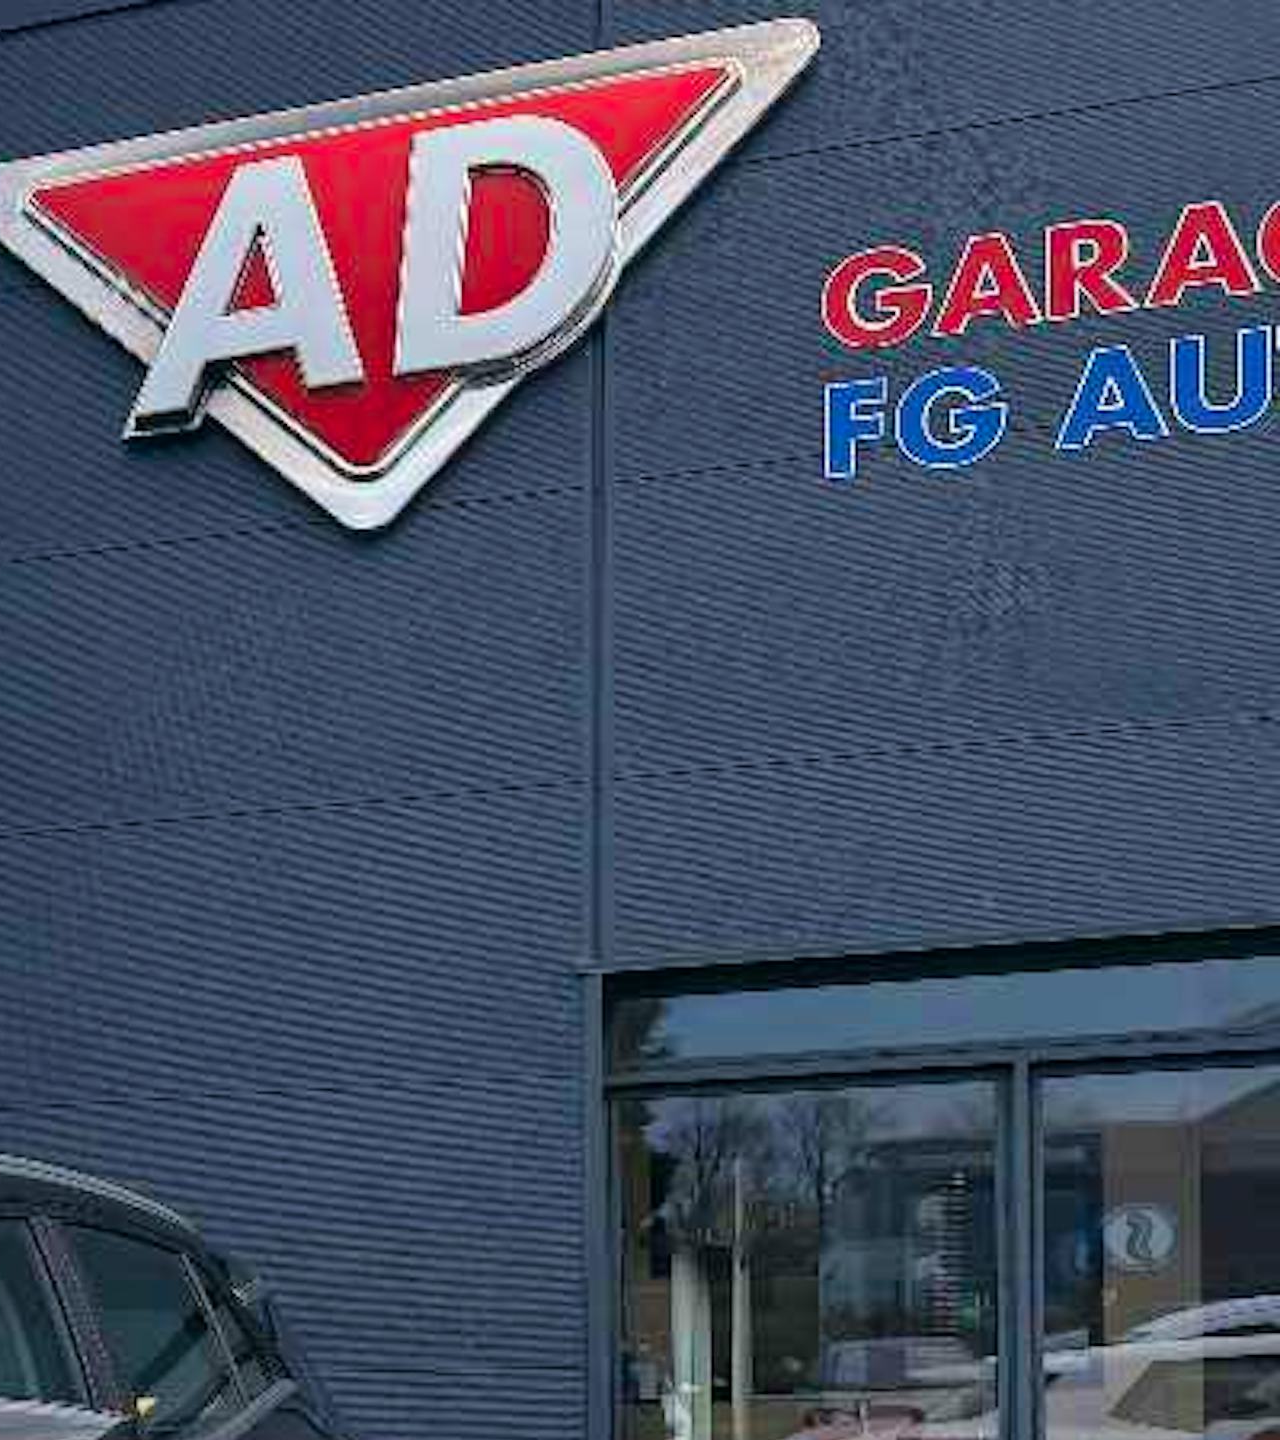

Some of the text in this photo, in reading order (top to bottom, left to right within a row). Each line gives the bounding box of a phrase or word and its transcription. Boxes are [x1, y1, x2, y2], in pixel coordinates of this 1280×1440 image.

[124, 114, 621, 440] AD
[820, 199, 1280, 348] GARA
[823, 324, 1280, 479] FG AU
